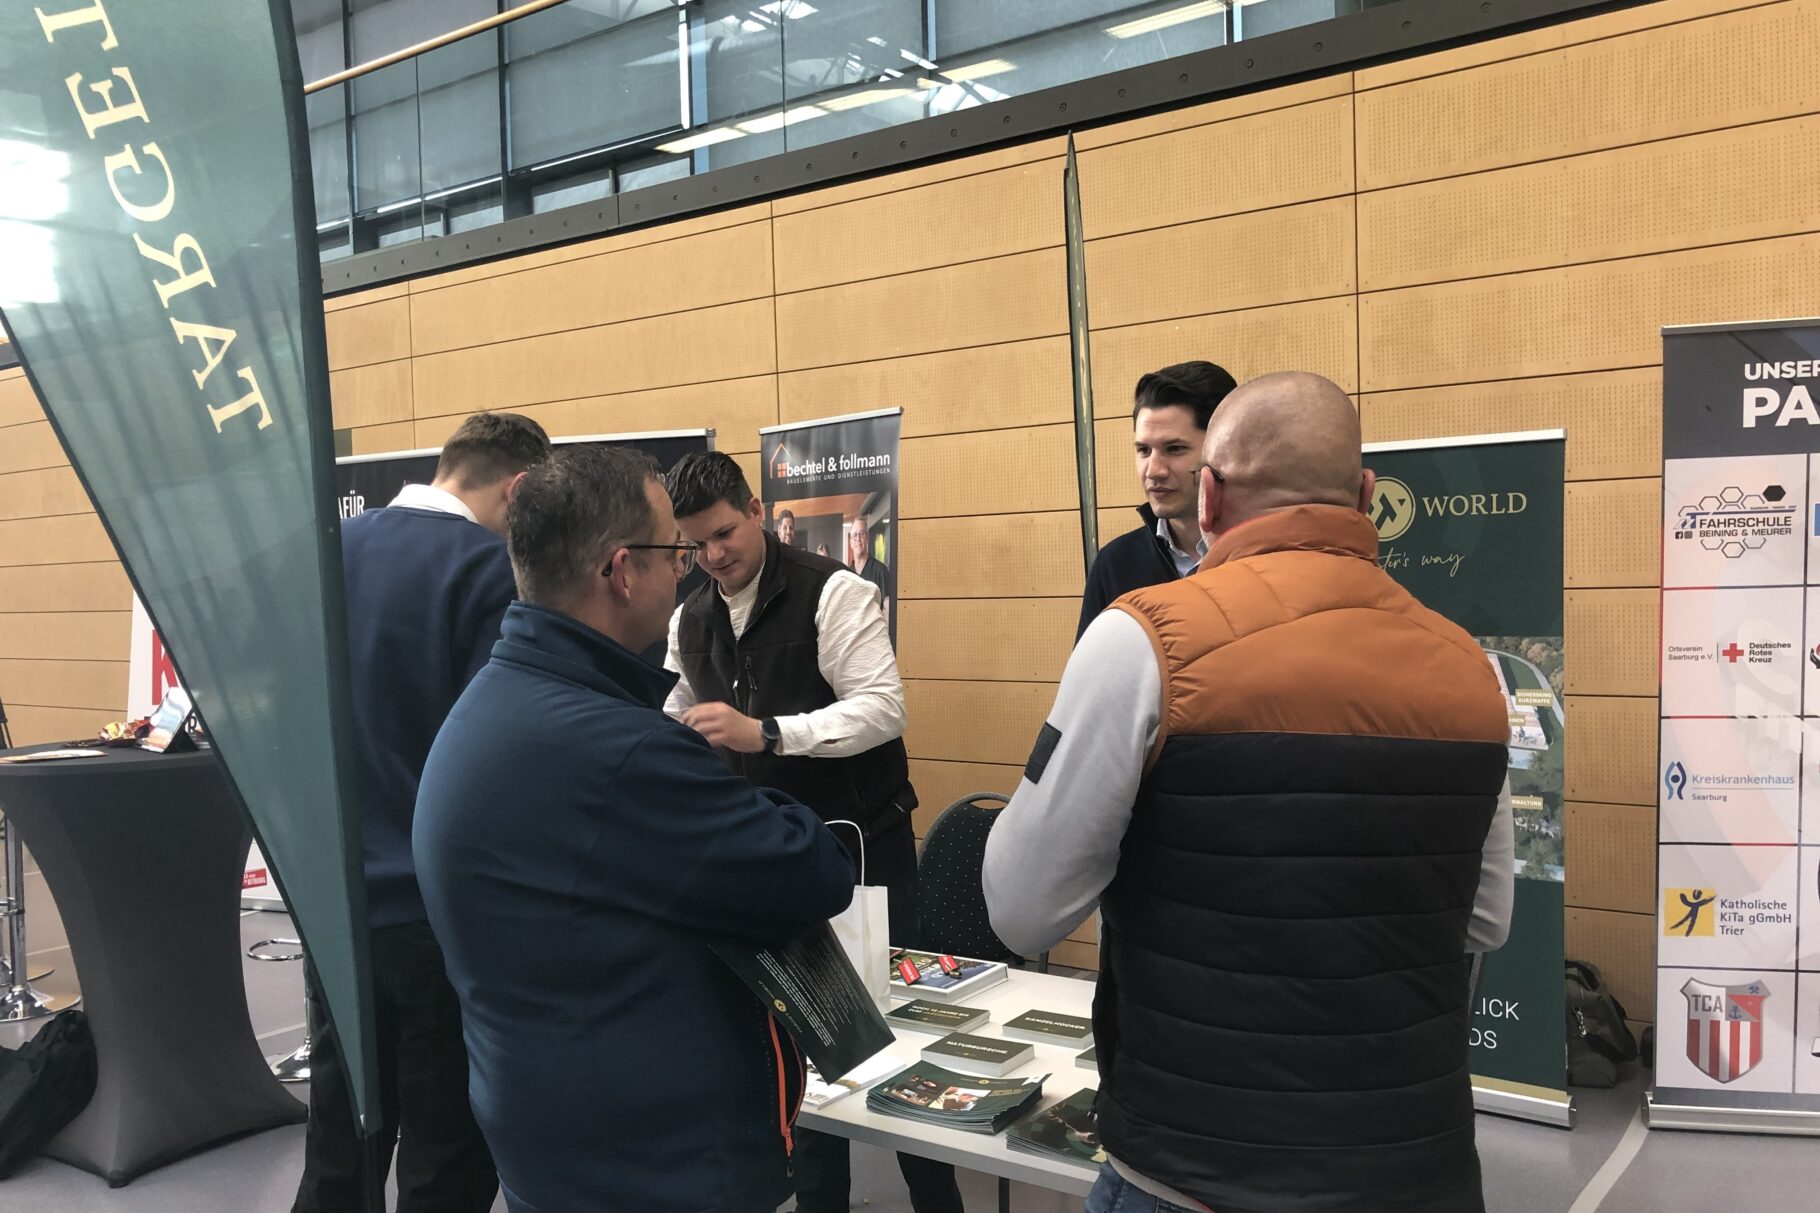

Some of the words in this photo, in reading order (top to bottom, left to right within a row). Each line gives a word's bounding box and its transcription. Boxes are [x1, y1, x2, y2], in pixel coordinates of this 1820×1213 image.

[786, 457, 825, 477] bechtel
[827, 457, 838, 472] &
[839, 453, 891, 471] follmann
[837, 467, 891, 479] DIENSTLEISTUNGEN
[1422, 492, 1527, 518] WORLD
[1699, 516, 1792, 529] FAHRSCHULE
[1699, 529, 1738, 538] BEINING
[1741, 529, 1749, 537] &
[1751, 527, 1792, 536] MEURER
[1421, 552, 1465, 577] way
[1692, 774, 1795, 784] Kreiskrankenhaus
[1692, 794, 1727, 802] Saarburg
[1720, 899, 1787, 910] Katholische
[1720, 912, 1744, 923] KiTa
[1748, 913, 1791, 925] gGmbH
[1720, 925, 1744, 936] Trier
[1475, 997, 1519, 1021] ICK
[1692, 994, 1723, 1012] TCA
